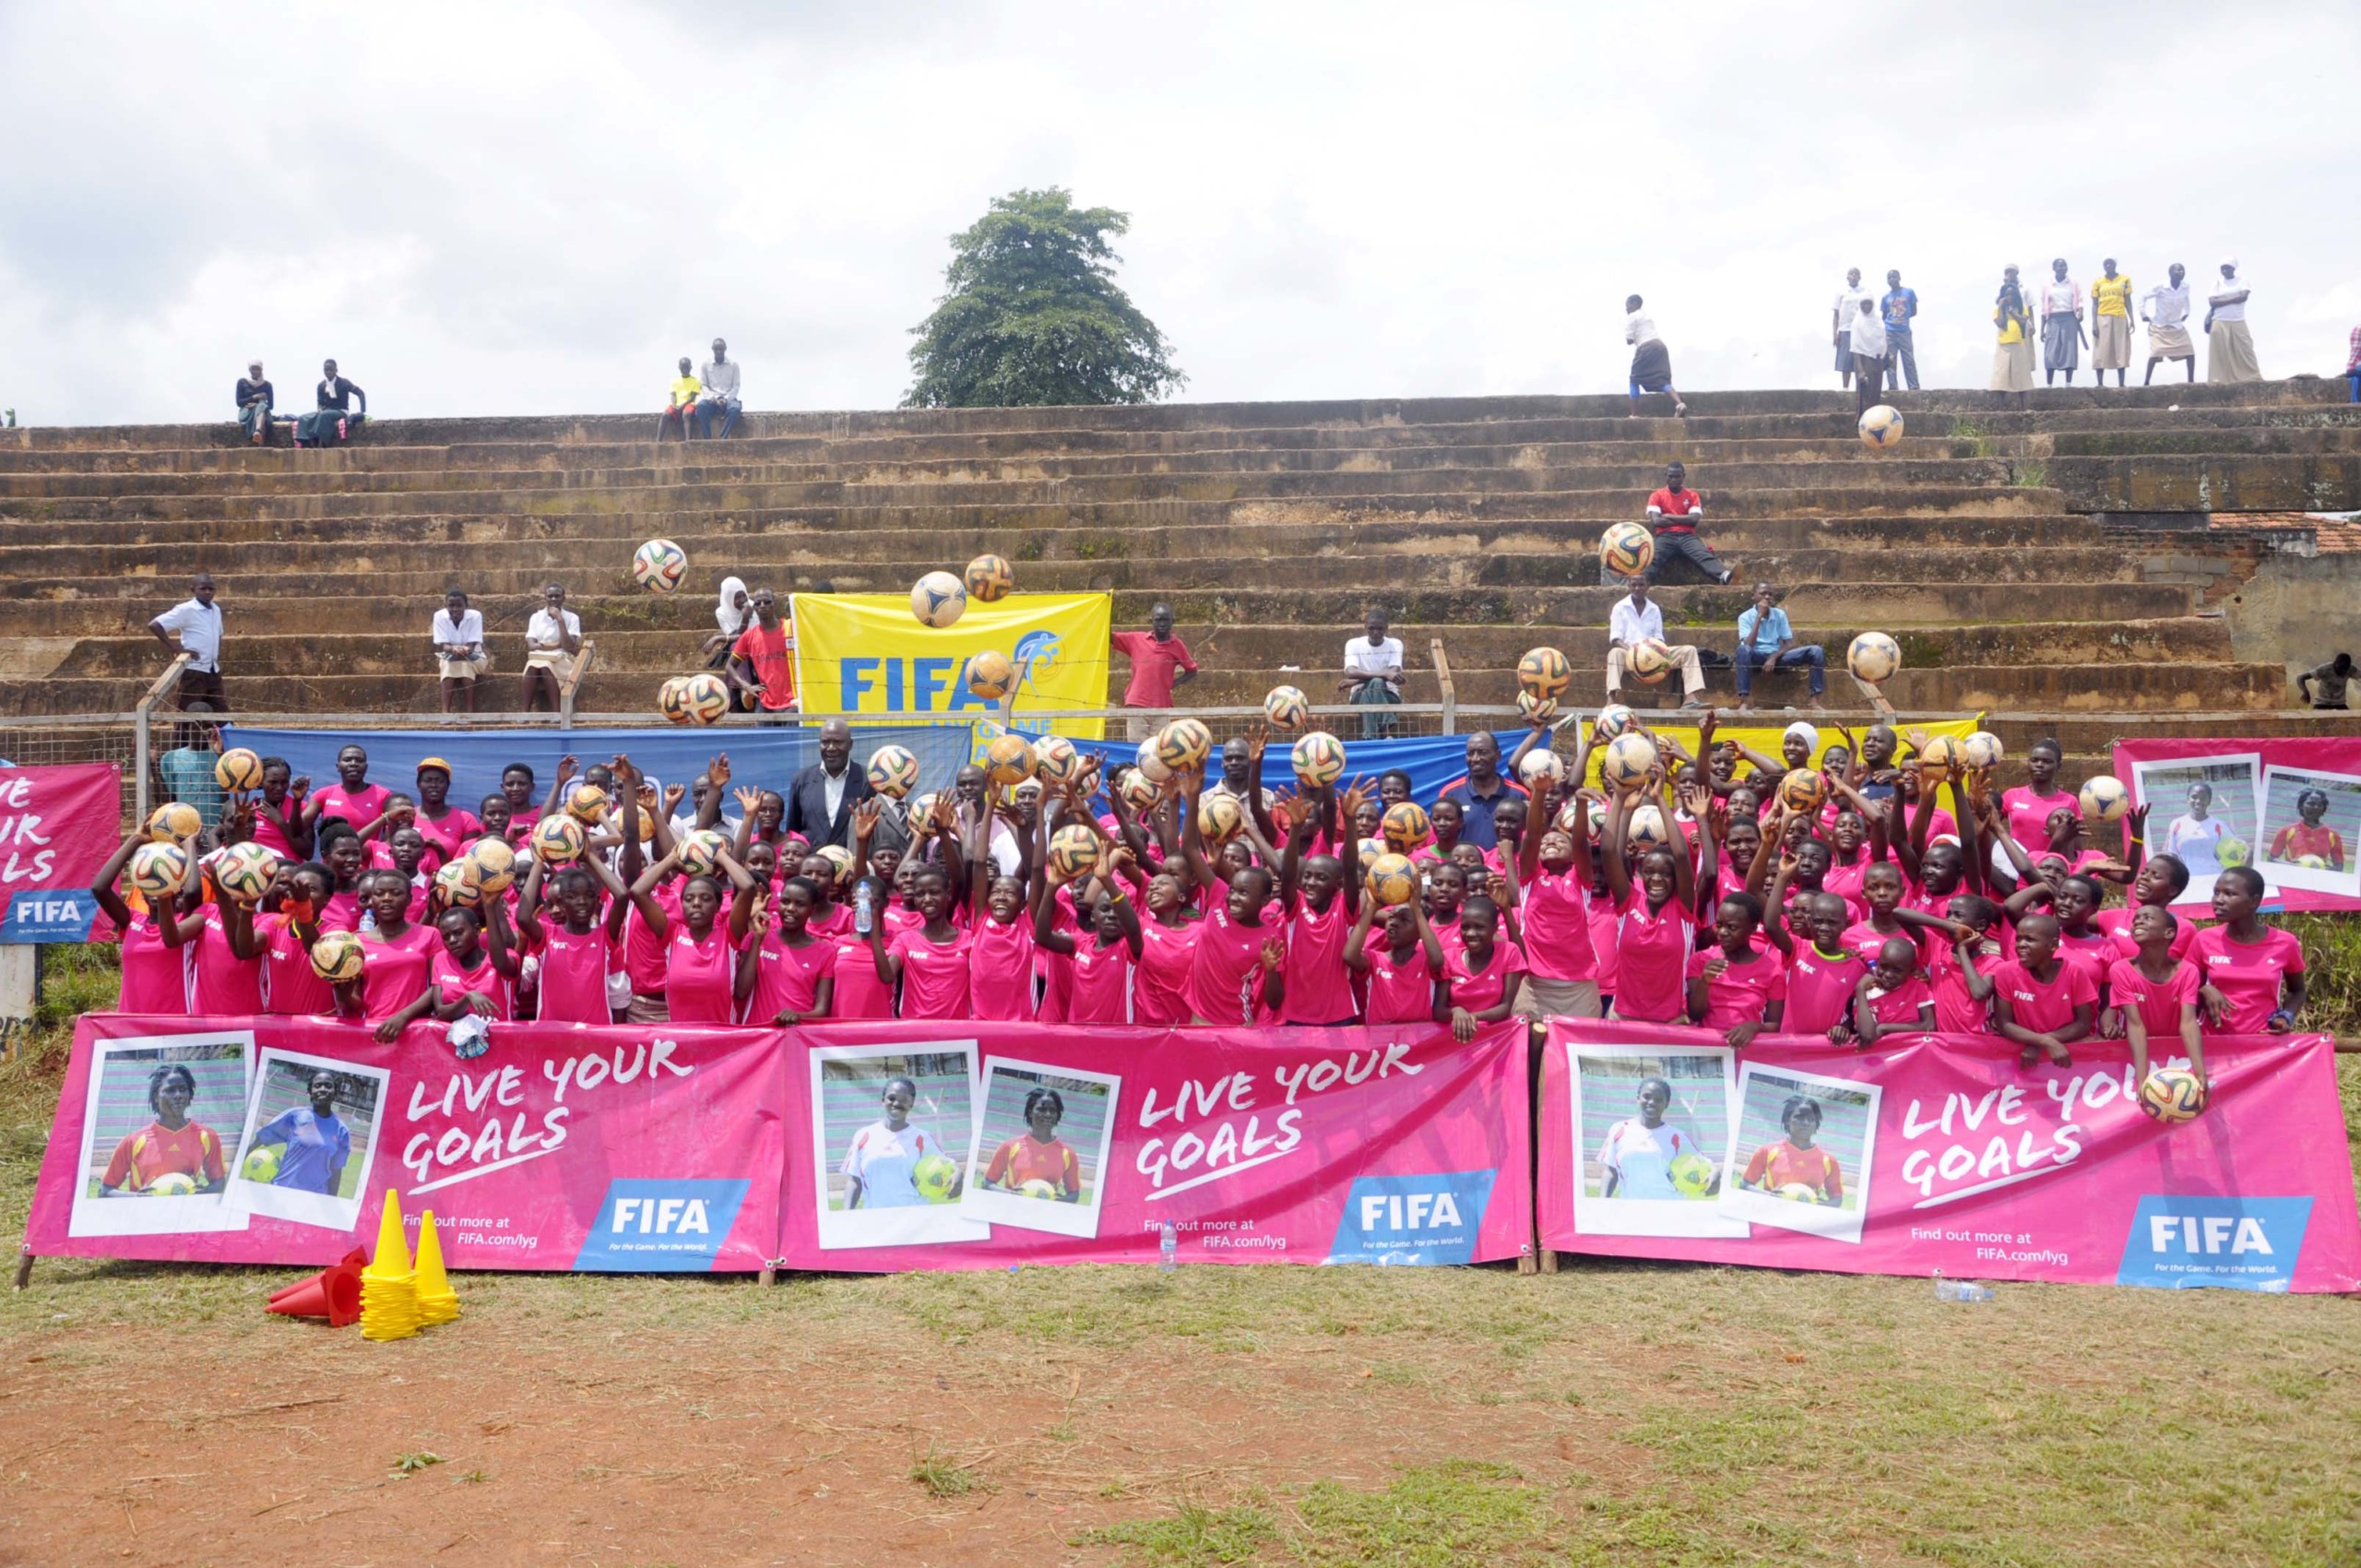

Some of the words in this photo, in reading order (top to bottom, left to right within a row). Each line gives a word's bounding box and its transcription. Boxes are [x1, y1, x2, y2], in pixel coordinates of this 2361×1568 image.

[17, 900, 82, 923] FIFA
[1215, 909, 1228, 927] FIFA
[1631, 909, 1645, 924] FIFA
[677, 935, 694, 946] FIFA
[1860, 941, 1880, 949] FIFA
[760, 950, 778, 960] FIFA
[909, 951, 928, 959] FIFA
[1075, 952, 1090, 965] FIFA
[1797, 959, 1815, 974] FIFA
[441, 975, 459, 983] FIFA
[2014, 991, 2035, 1001] FIFA
[407, 1064, 525, 1122] LIVE
[544, 1039, 694, 1102] YOUR
[1139, 1071, 1257, 1127] LIVE
[1275, 1043, 1424, 1105] YOUR
[1903, 1084, 2028, 1139] LIVE
[403, 1107, 570, 1182] GOALS
[1136, 1109, 1302, 1187] GOALS
[1902, 1124, 2082, 1197] GOALS
[611, 1199, 709, 1233] FIFA
[1360, 1193, 1462, 1231] FIFA
[403, 1214, 421, 1225] Fin
[433, 1217, 456, 1227] out
[459, 1218, 492, 1228] more
[496, 1218, 509, 1229] at
[1144, 1219, 1164, 1231] Fin
[1176, 1220, 1199, 1230] out
[1203, 1220, 1237, 1230] more
[1240, 1219, 1254, 1230] at
[457, 1232, 538, 1249] FIFA.com/lyg
[1203, 1234, 1286, 1250] FIFA.com/lyg
[1441, 1236, 1465, 1245] World.
[1911, 1228, 1941, 1240] Find
[1946, 1230, 1971, 1241] out
[1975, 1232, 2012, 1243] more
[2016, 1232, 2032, 1244] at
[2150, 1216, 2273, 1254] FIFA
[1976, 1247, 2069, 1265] FIFA.com/lyg
[2169, 1264, 2185, 1272] the
[2186, 1265, 2213, 1273] Game.
